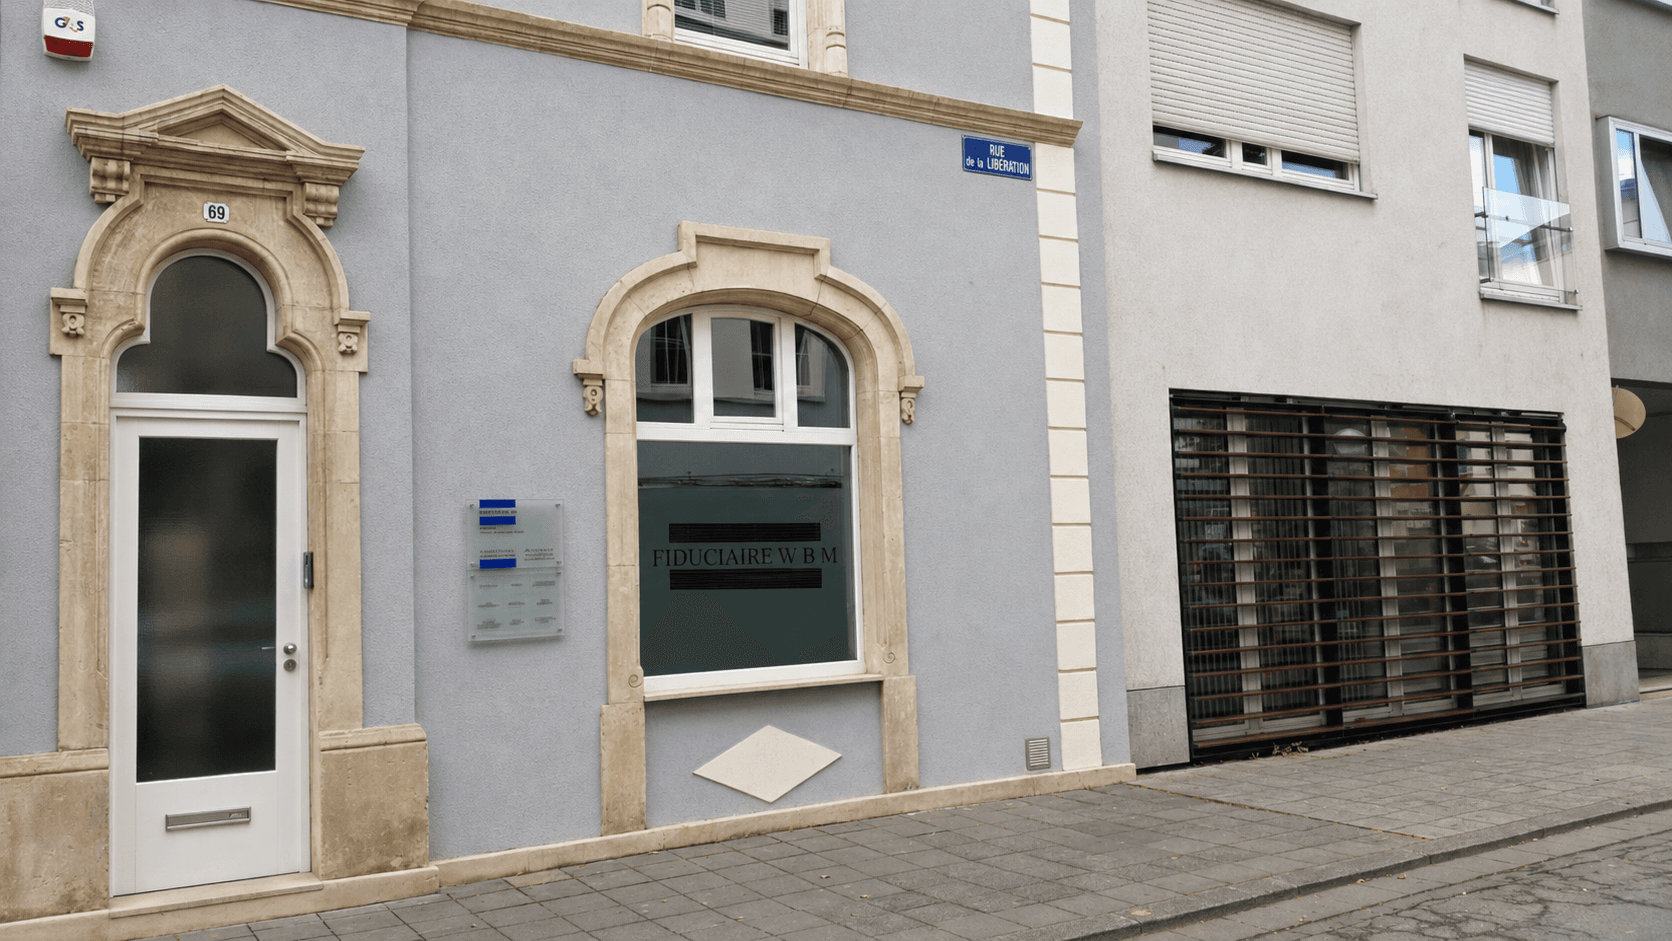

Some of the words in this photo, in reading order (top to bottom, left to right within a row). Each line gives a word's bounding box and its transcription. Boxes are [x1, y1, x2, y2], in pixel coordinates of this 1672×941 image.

[989, 144, 1005, 158] RUE
[966, 156, 975, 167] de
[977, 157, 984, 168] la
[208, 204, 225, 220] 69
[652, 547, 774, 568] FIDUCIAIRE
[777, 547, 798, 565] W
[802, 547, 816, 565] B
[821, 546, 838, 564] M
